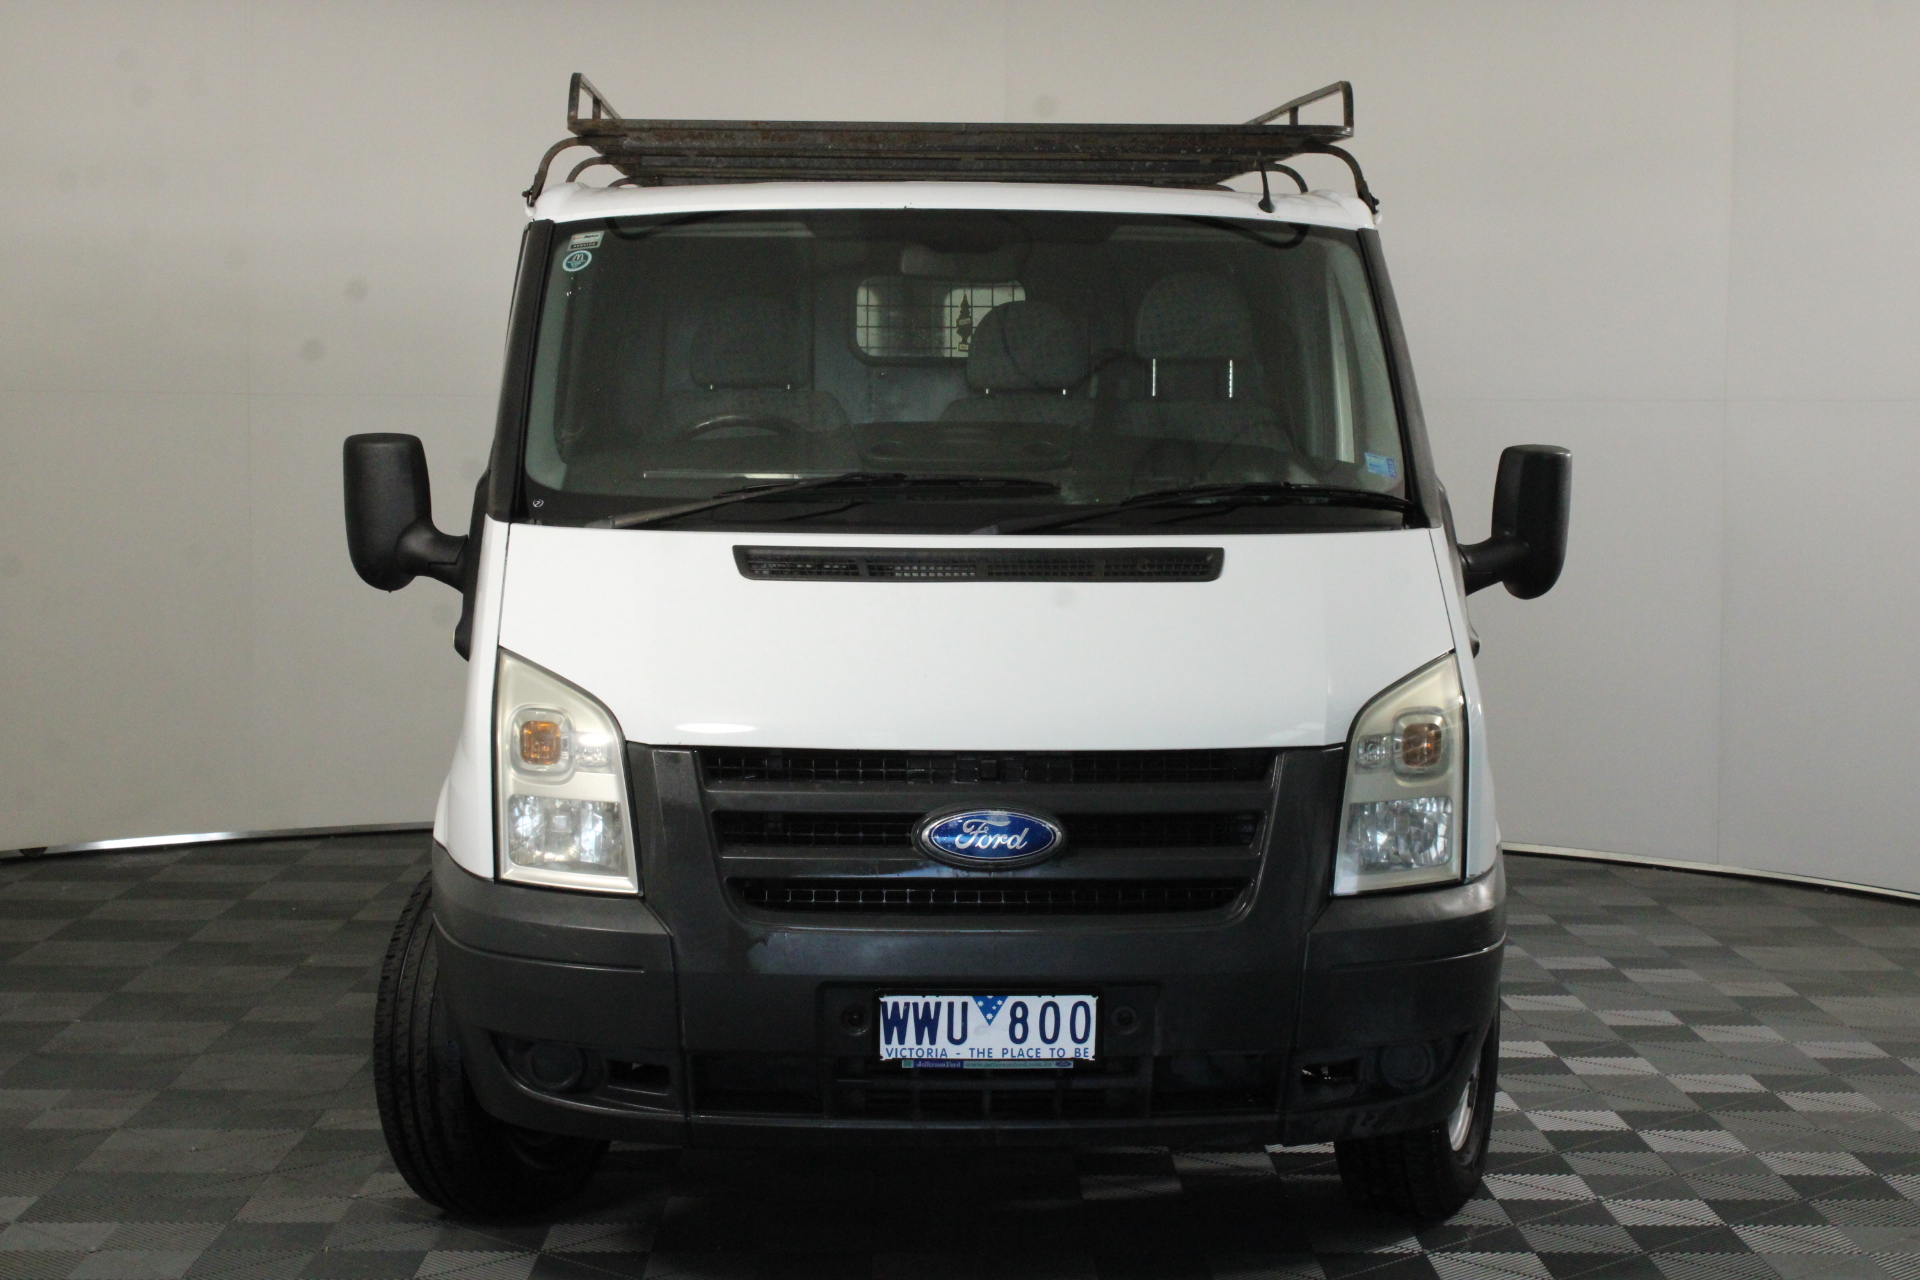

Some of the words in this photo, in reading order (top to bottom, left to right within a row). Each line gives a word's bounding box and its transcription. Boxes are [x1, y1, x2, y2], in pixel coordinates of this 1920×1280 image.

[954, 818, 1030, 850] Ford
[881, 1001, 968, 1046] WWU
[1009, 1001, 1091, 1045] 800
[885, 1048, 948, 1058] VICTORIA
[969, 1048, 993, 1058] THE
[1002, 1048, 1041, 1058] PLACE
[1050, 1048, 1066, 1058] TO
[1074, 1048, 1090, 1058] BE
